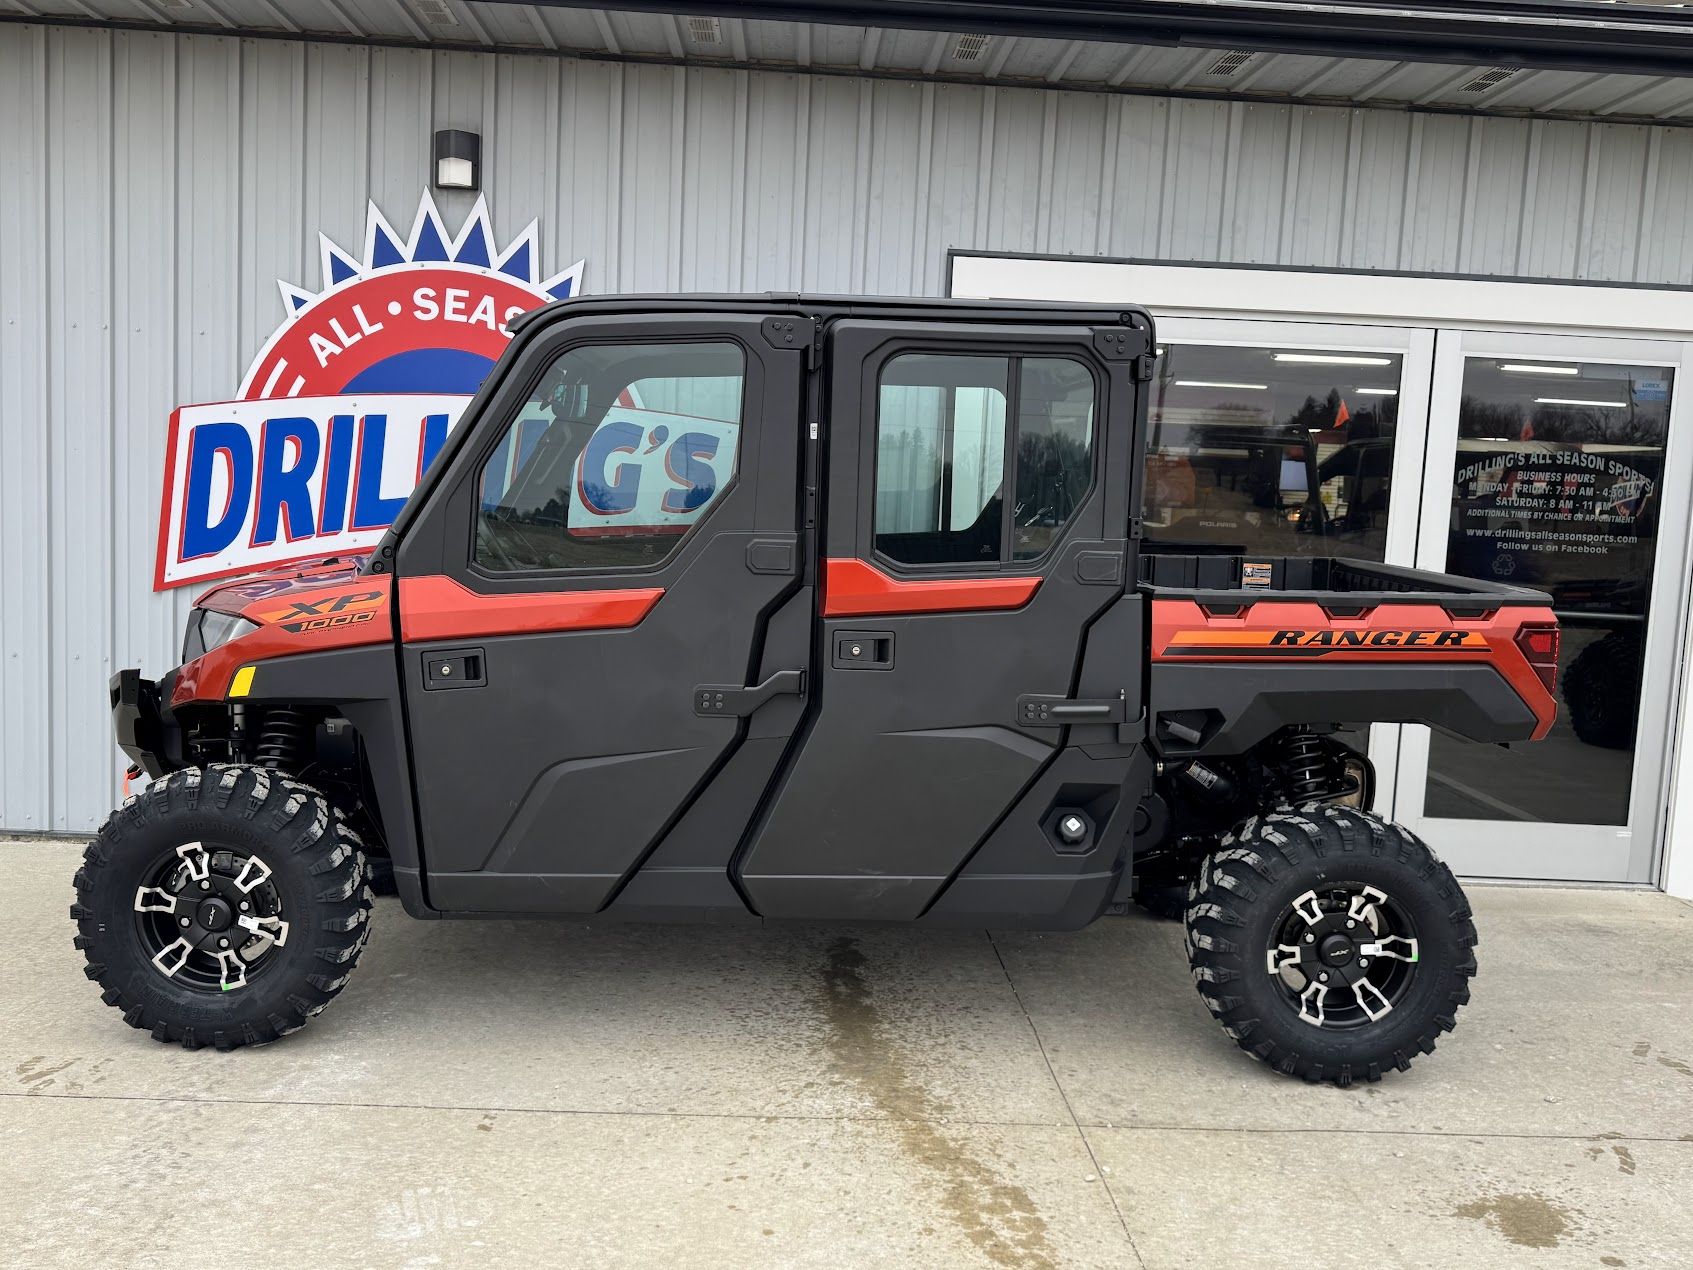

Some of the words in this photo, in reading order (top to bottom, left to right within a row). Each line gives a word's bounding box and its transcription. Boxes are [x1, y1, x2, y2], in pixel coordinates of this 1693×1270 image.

[307, 303, 384, 369] ALL
[412, 286, 526, 339] SEAS
[1457, 452, 1526, 484] DRILLING'S
[1528, 451, 1553, 465] ALL
[1556, 451, 1606, 472] SEASON
[1608, 460, 1652, 493] SPORTS
[1516, 470, 1562, 482] BUSINESS
[1563, 473, 1597, 484] HOURS
[177, 413, 721, 564] DRILIG'S
[1556, 485, 1577, 496] 7:30
[1578, 486, 1595, 497] AM
[1495, 496, 1548, 508] SATURDAY:
[1549, 499, 1556, 508] 8
[1558, 499, 1574, 509] AM
[1582, 501, 1593, 510] 11
[1594, 501, 1611, 511] AM
[1466, 508, 1510, 518] ADDITIONAL
[1511, 510, 1532, 519] TIMES
[1533, 511, 1543, 519] BY
[1544, 512, 1573, 521] CHANCE
[1573, 513, 1584, 521] OR
[1466, 528, 1638, 544] www.drillingsallseasonsports.com
[1496, 541, 1530, 551] Follow
[1545, 544, 1559, 552] on
[1561, 544, 1609, 554] Facebook
[276, 590, 384, 621] XP
[299, 610, 377, 632] 1000
[1268, 630, 1470, 646] RANGER
